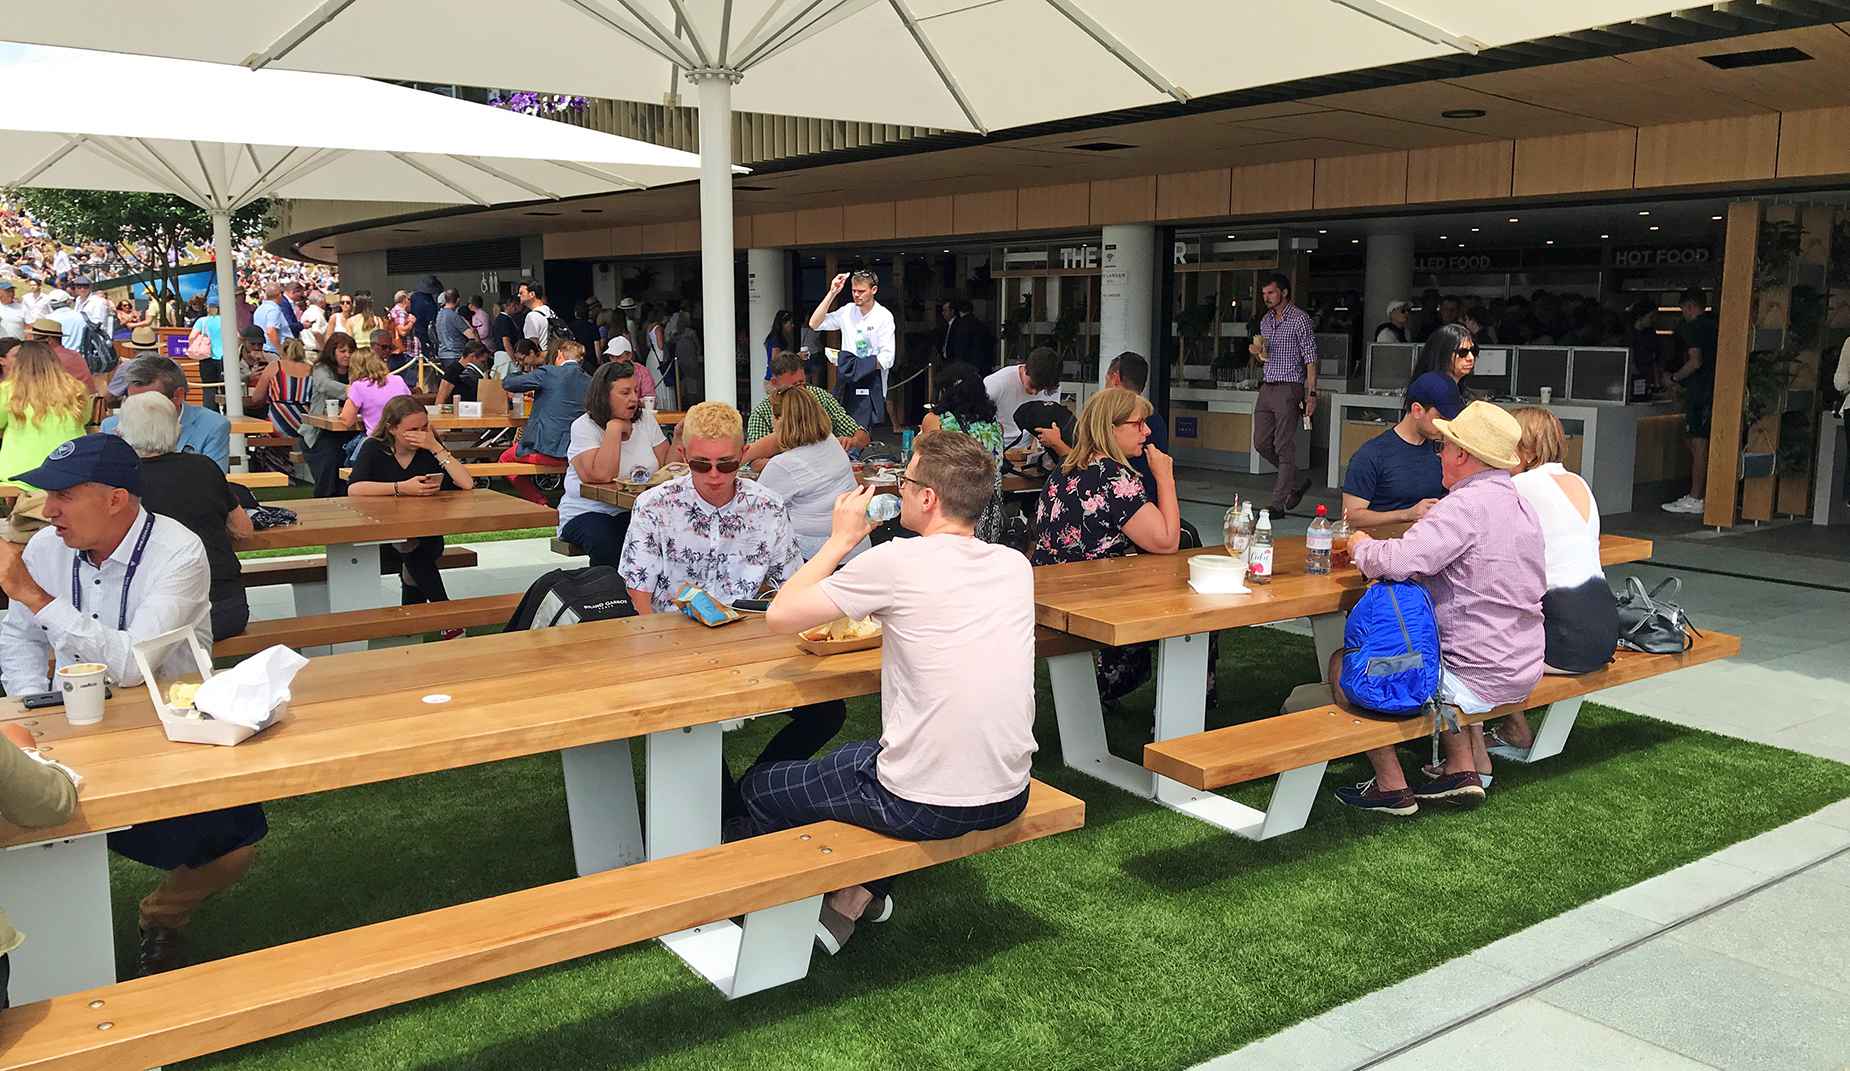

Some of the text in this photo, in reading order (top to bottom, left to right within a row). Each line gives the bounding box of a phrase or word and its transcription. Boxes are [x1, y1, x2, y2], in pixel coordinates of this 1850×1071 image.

[1060, 247, 1098, 269] THE
[1449, 256, 1490, 270] FOOD
[1616, 248, 1709, 265] HOT FOOD
